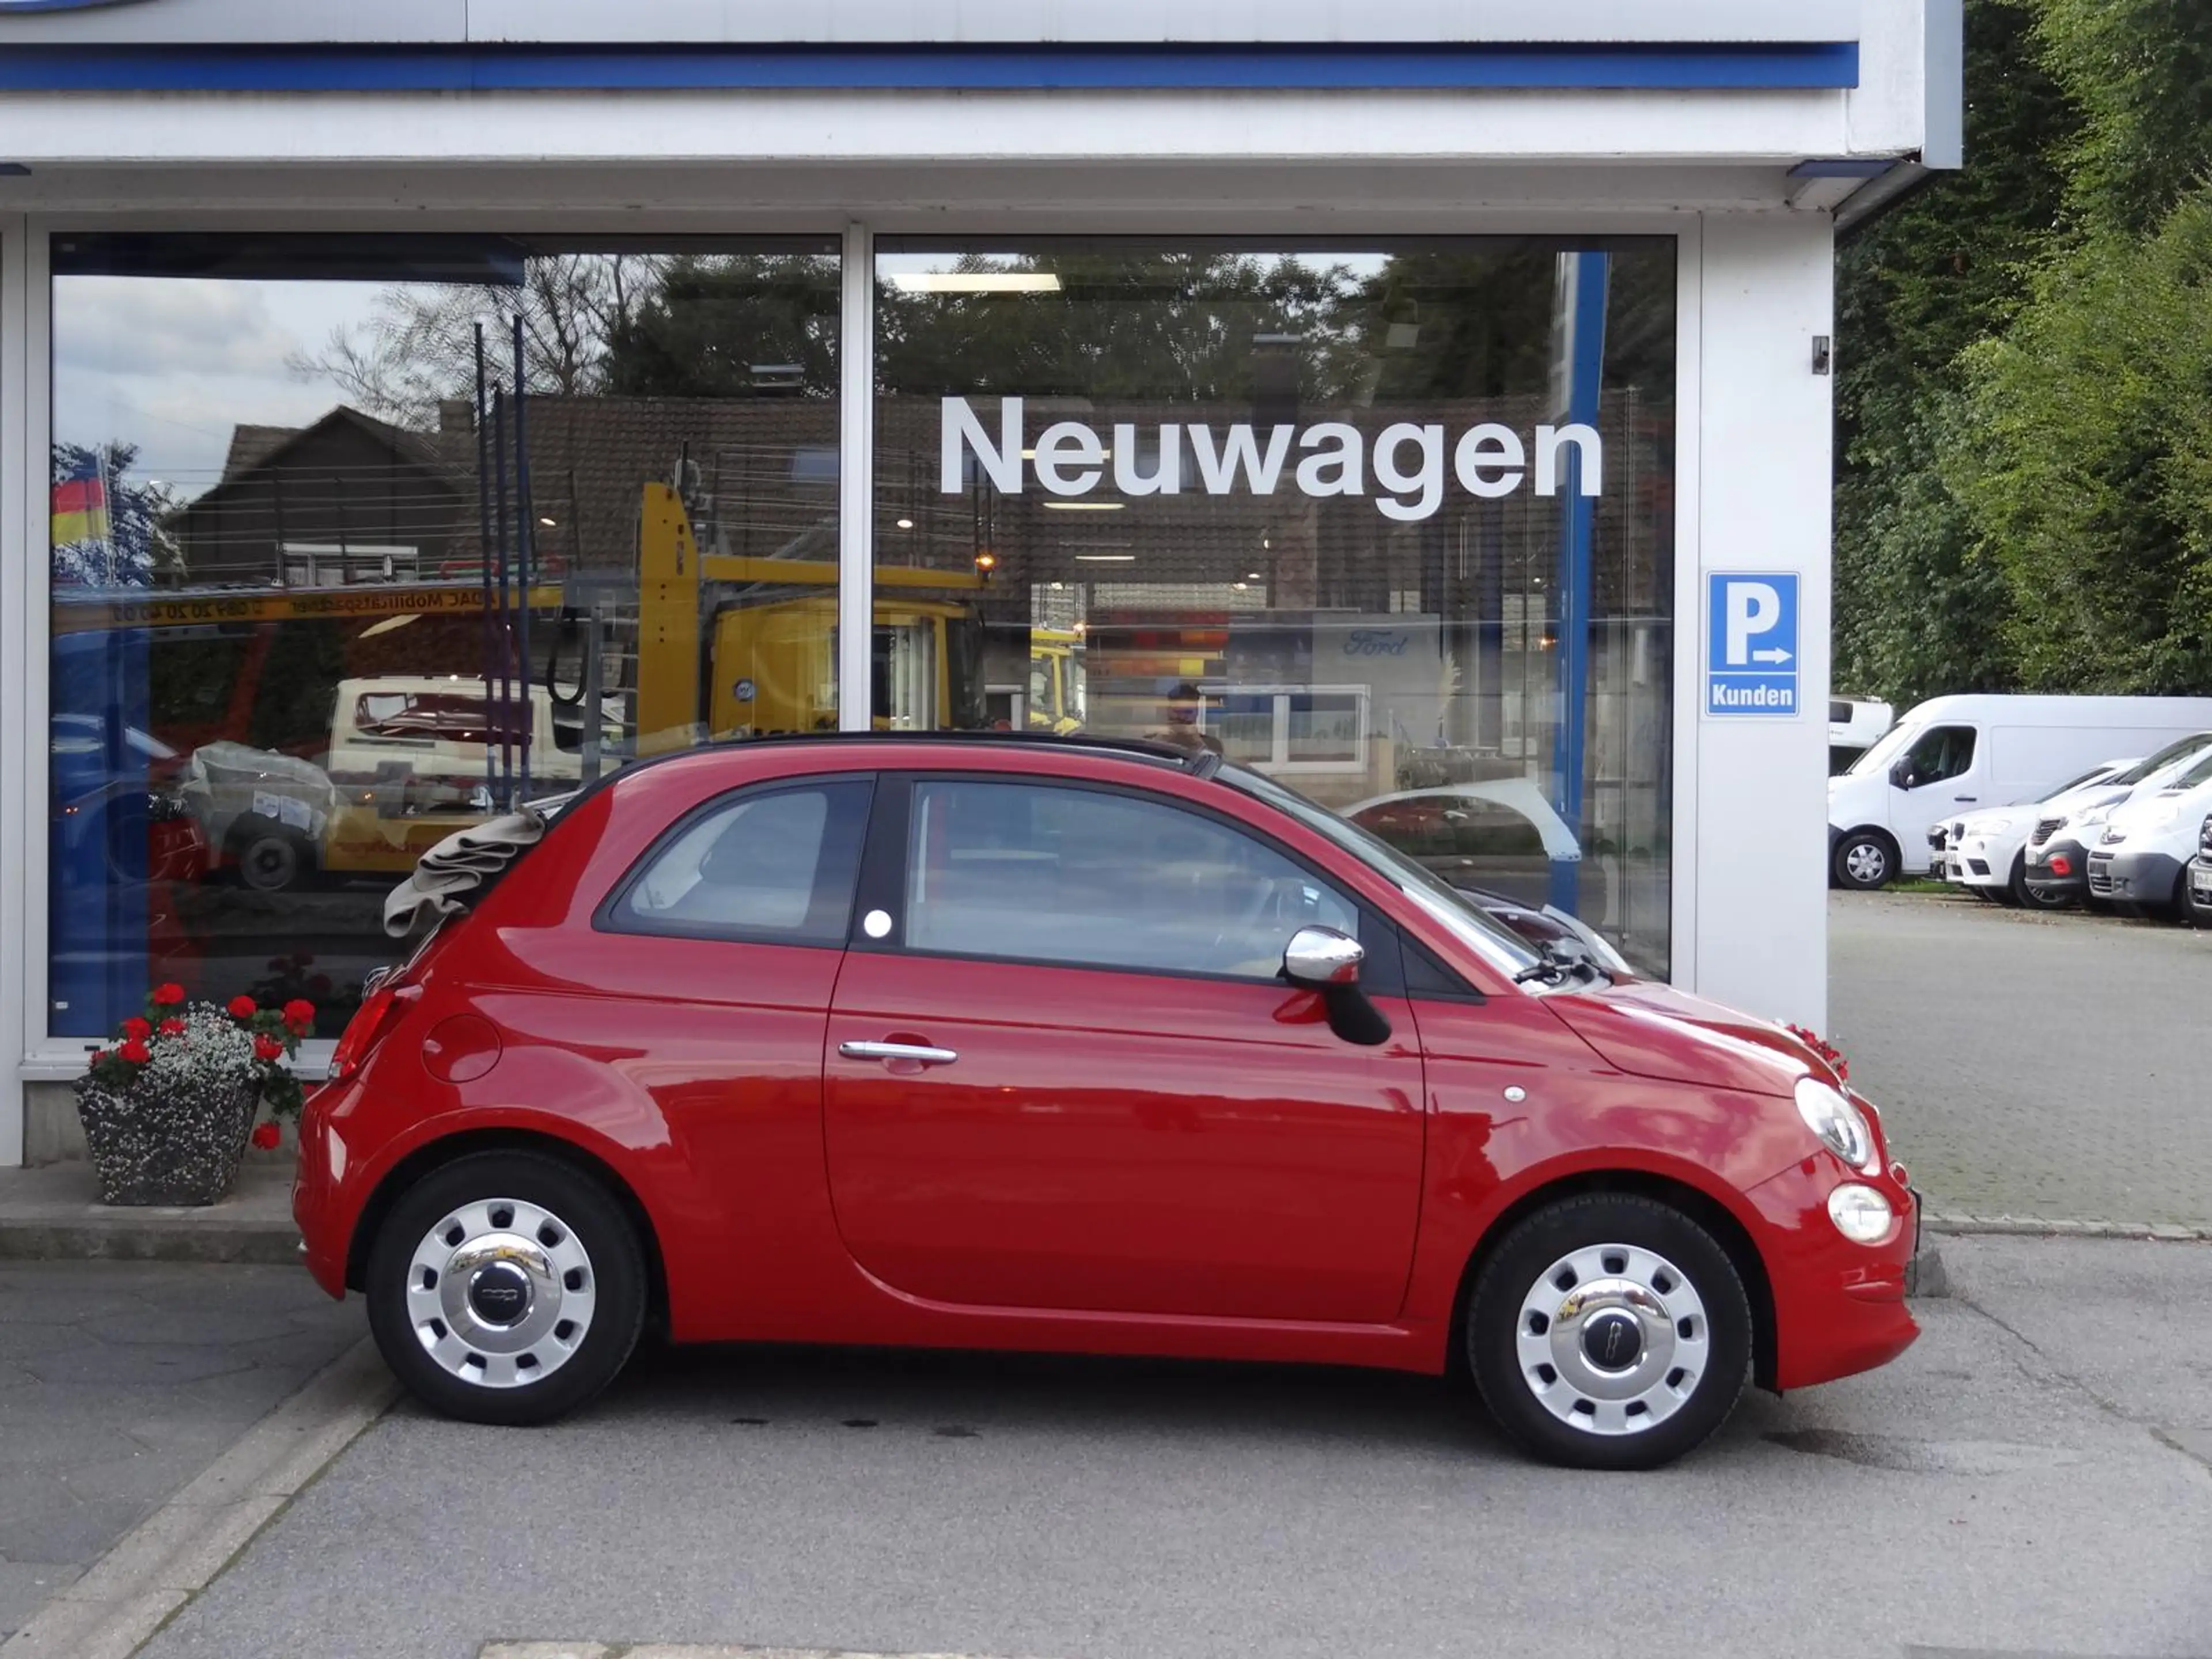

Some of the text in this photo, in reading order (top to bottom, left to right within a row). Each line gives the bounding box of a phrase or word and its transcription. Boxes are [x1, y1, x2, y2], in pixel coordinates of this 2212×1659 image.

[941, 396, 1603, 521] Neuwagen
[1343, 629, 1409, 656] Ford
[1727, 582, 1779, 665] P
[1713, 684, 1793, 706] Kunden
